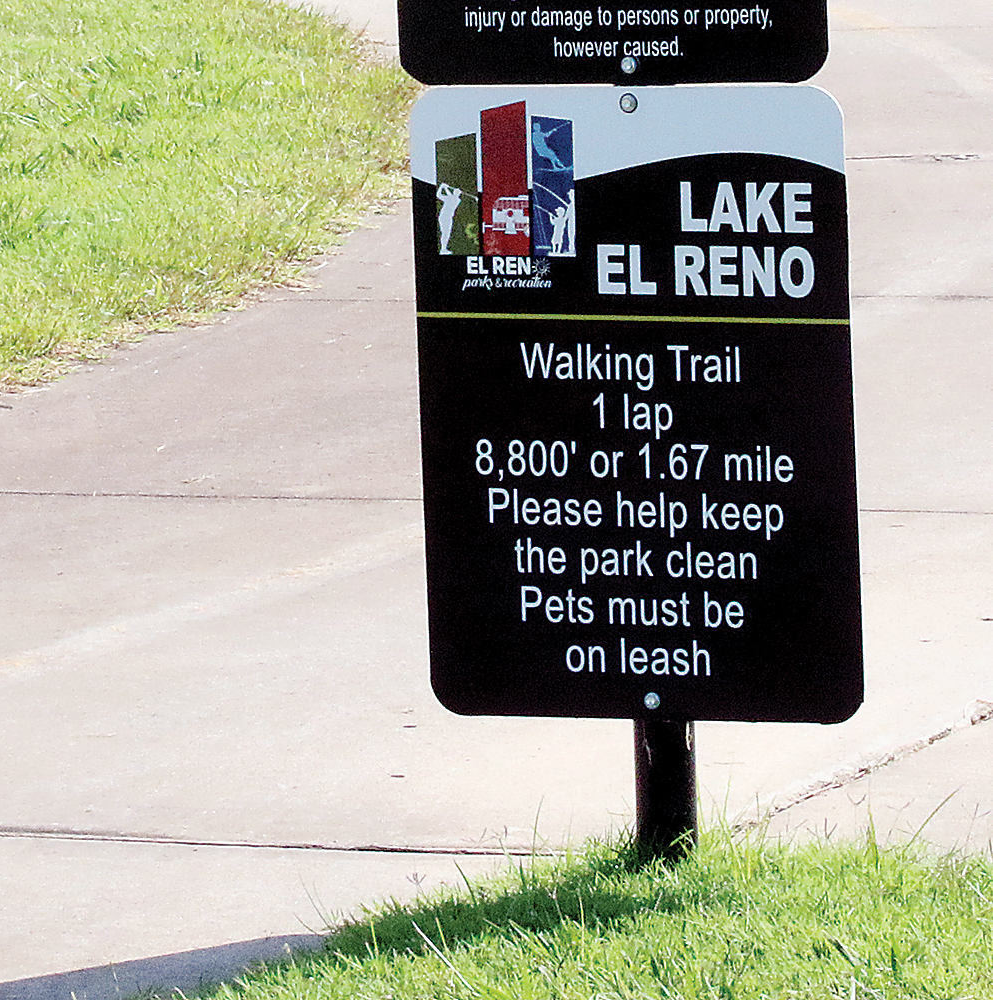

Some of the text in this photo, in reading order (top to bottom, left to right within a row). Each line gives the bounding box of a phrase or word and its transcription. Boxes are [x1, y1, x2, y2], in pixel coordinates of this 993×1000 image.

[465, 5, 772, 32] injury or damage to persons or property,
[554, 36, 684, 57] however caused.
[680, 181, 813, 233] LAKE
[467, 256, 489, 274] EL
[597, 244, 815, 298] EL RENO
[520, 342, 740, 391] Walking Trail
[593, 393, 673, 439] 1 lap
[475, 439, 794, 482] 8,800' or 1.67 mile
[488, 488, 784, 540] Please help keep
[514, 537, 757, 584] the park clean
[521, 585, 744, 628] Pets must be
[566, 638, 711, 676] on leash
